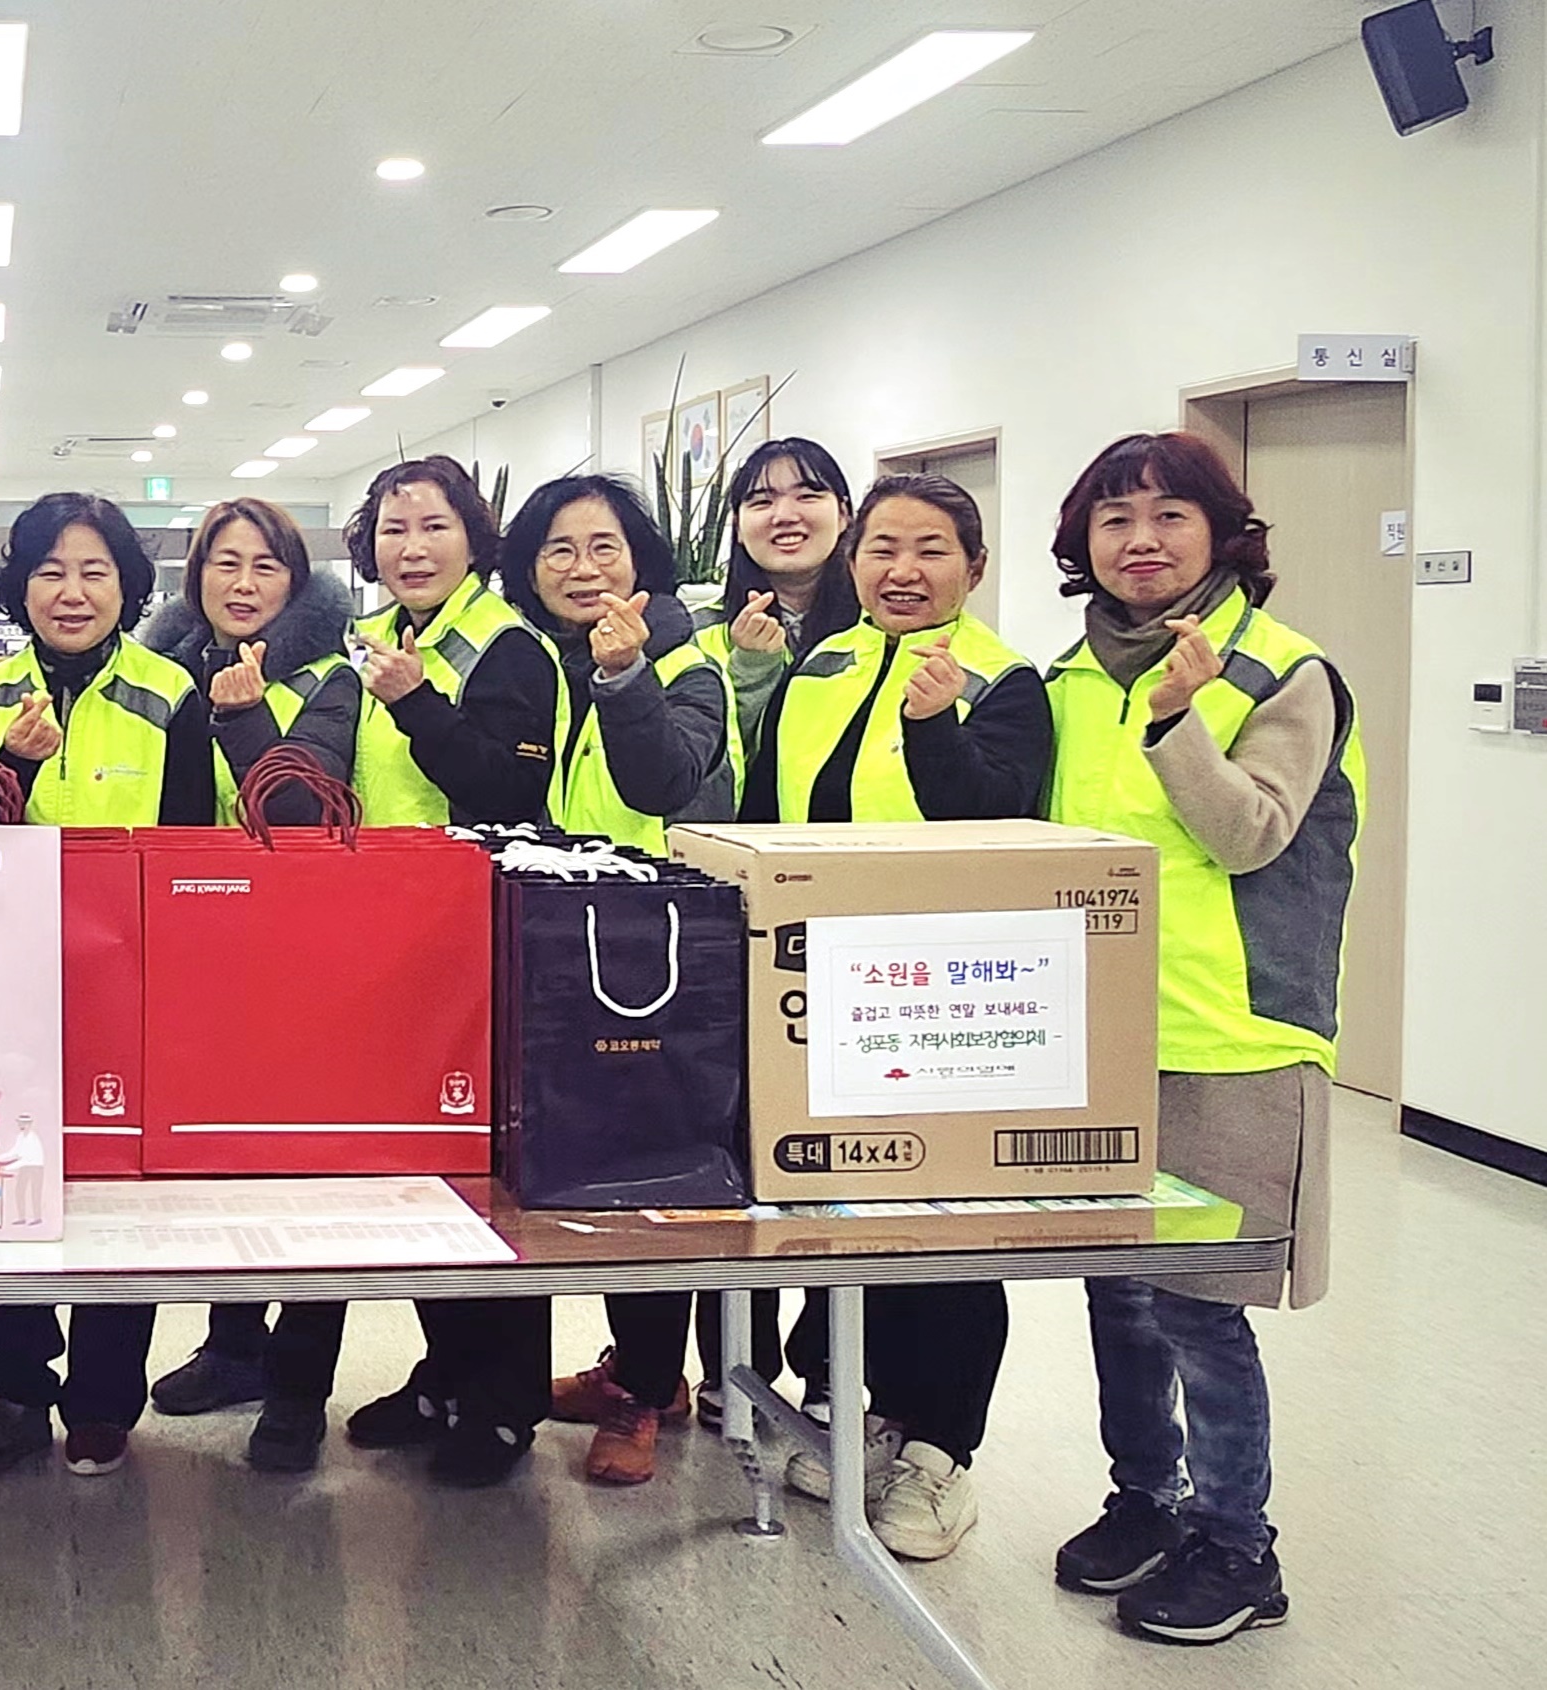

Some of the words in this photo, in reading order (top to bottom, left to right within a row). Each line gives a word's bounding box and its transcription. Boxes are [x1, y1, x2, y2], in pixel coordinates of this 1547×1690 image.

[226, 885, 251, 895] JANG
[1055, 889, 1140, 908] 11041974
[851, 1006, 892, 1022] 즐겁고
[899, 1004, 941, 1020] 따뜻한
[948, 1002, 976, 1019] 연말
[856, 1033, 902, 1054] 성포동
[909, 1028, 1047, 1051] 지역사회보장협의체
[785, 1141, 825, 1166] 특대
